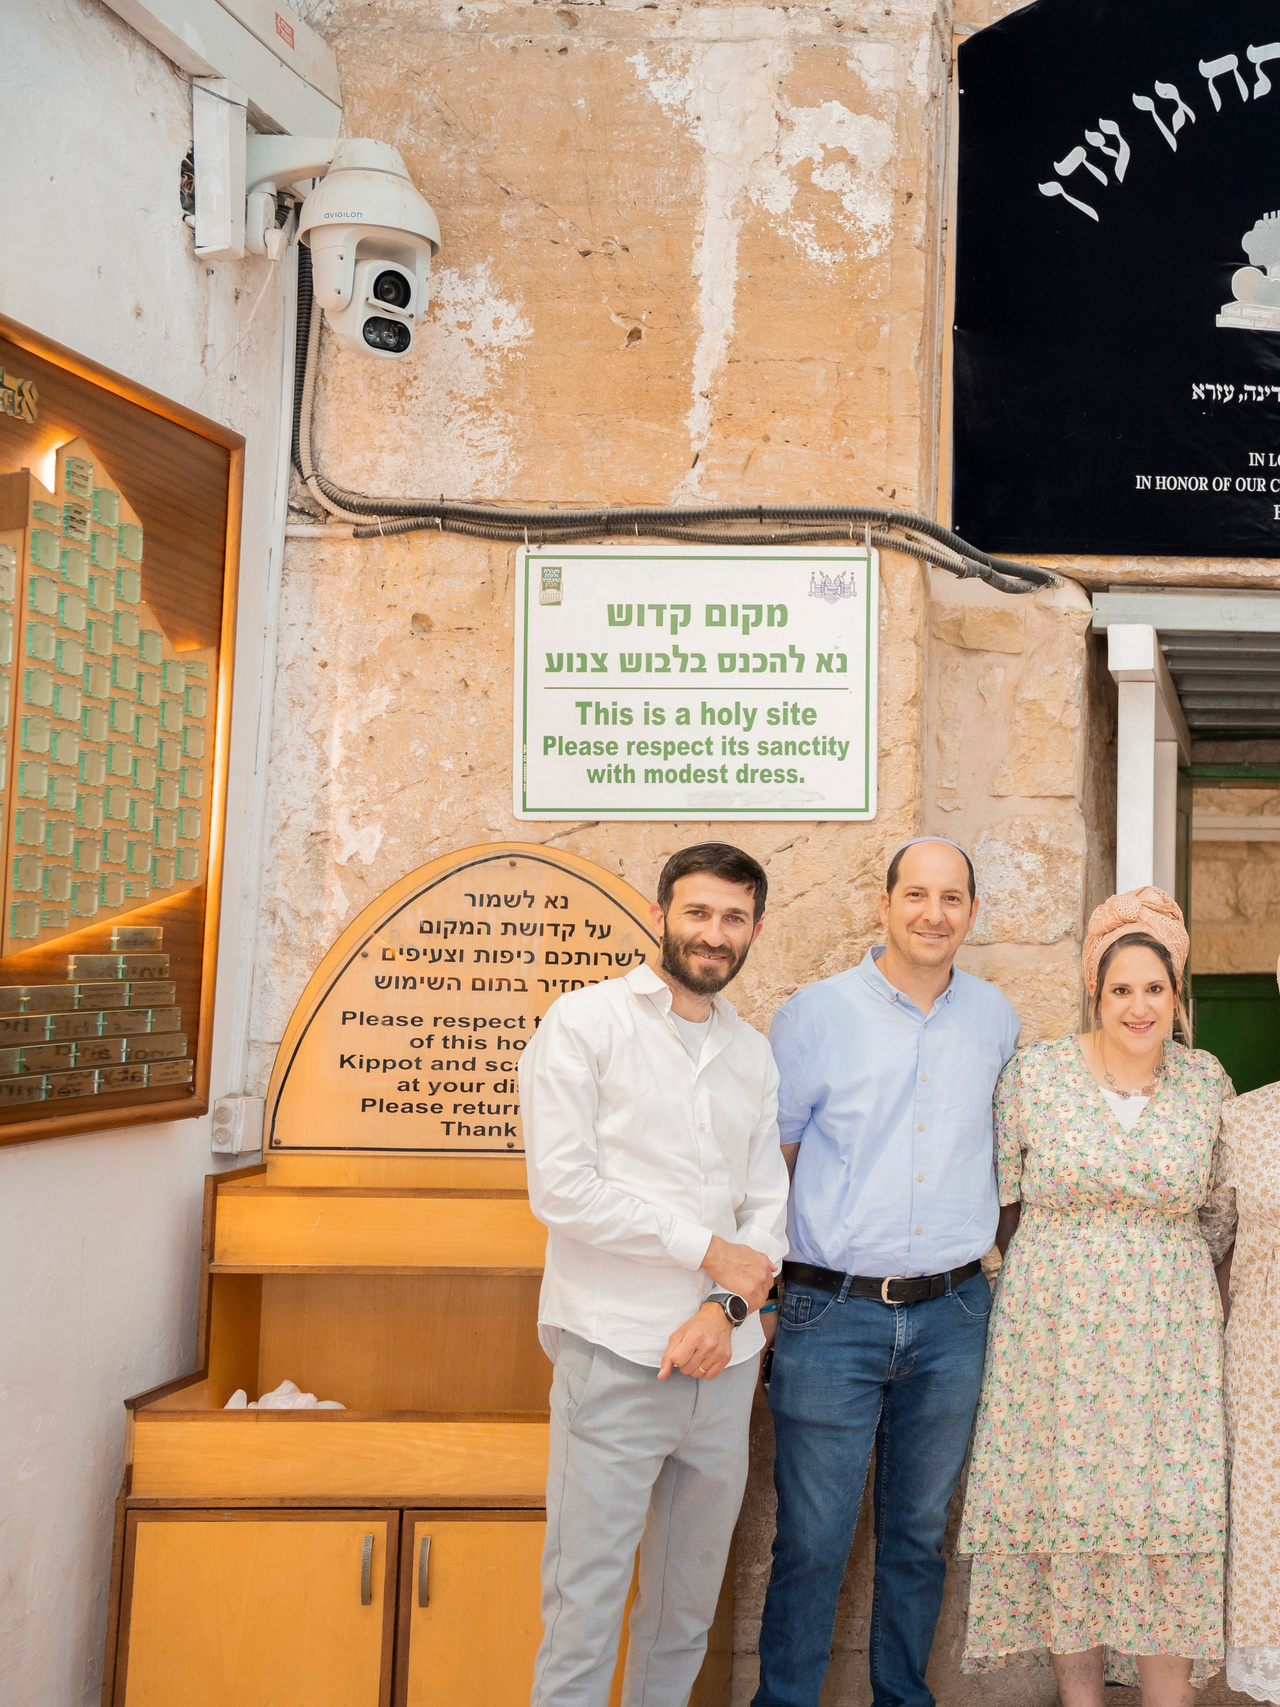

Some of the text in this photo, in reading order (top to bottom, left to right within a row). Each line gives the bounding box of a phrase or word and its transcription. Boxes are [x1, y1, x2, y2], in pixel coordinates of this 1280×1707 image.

[1131, 79, 1195, 152] גן
[1037, 117, 1130, 222] עדן
[1191, 382, 1234, 403] עזרא
[1248, 452, 1265, 466] IN
[1135, 474, 1151, 489] IN
[1154, 475, 1208, 491] HONOR
[1212, 476, 1231, 491] OF
[1235, 476, 1266, 491] OUR
[607, 603, 788, 635] מקום קדוש
[545, 644, 848, 673] נא להכנס בלבוש צנוע
[575, 701, 817, 732] This is a holy site
[543, 735, 850, 760] Please respect its sanctity
[587, 763, 805, 784] with modest dress.
[464, 889, 568, 909] נא לשמור
[419, 919, 611, 941] על קדושת המקום
[381, 947, 645, 966] לשרותכם כיפות וצעיפים
[374, 975, 608, 992] חזיר בתום השימוש
[341, 1010, 423, 1026] Please
[433, 1014, 525, 1031] respect
[409, 1034, 531, 1050] of this ho
[339, 1054, 422, 1073] Kippot
[430, 1056, 475, 1071] and
[396, 1077, 420, 1092] at
[427, 1081, 485, 1096] your
[361, 1097, 443, 1114] Please
[440, 1121, 516, 1136] Thank
